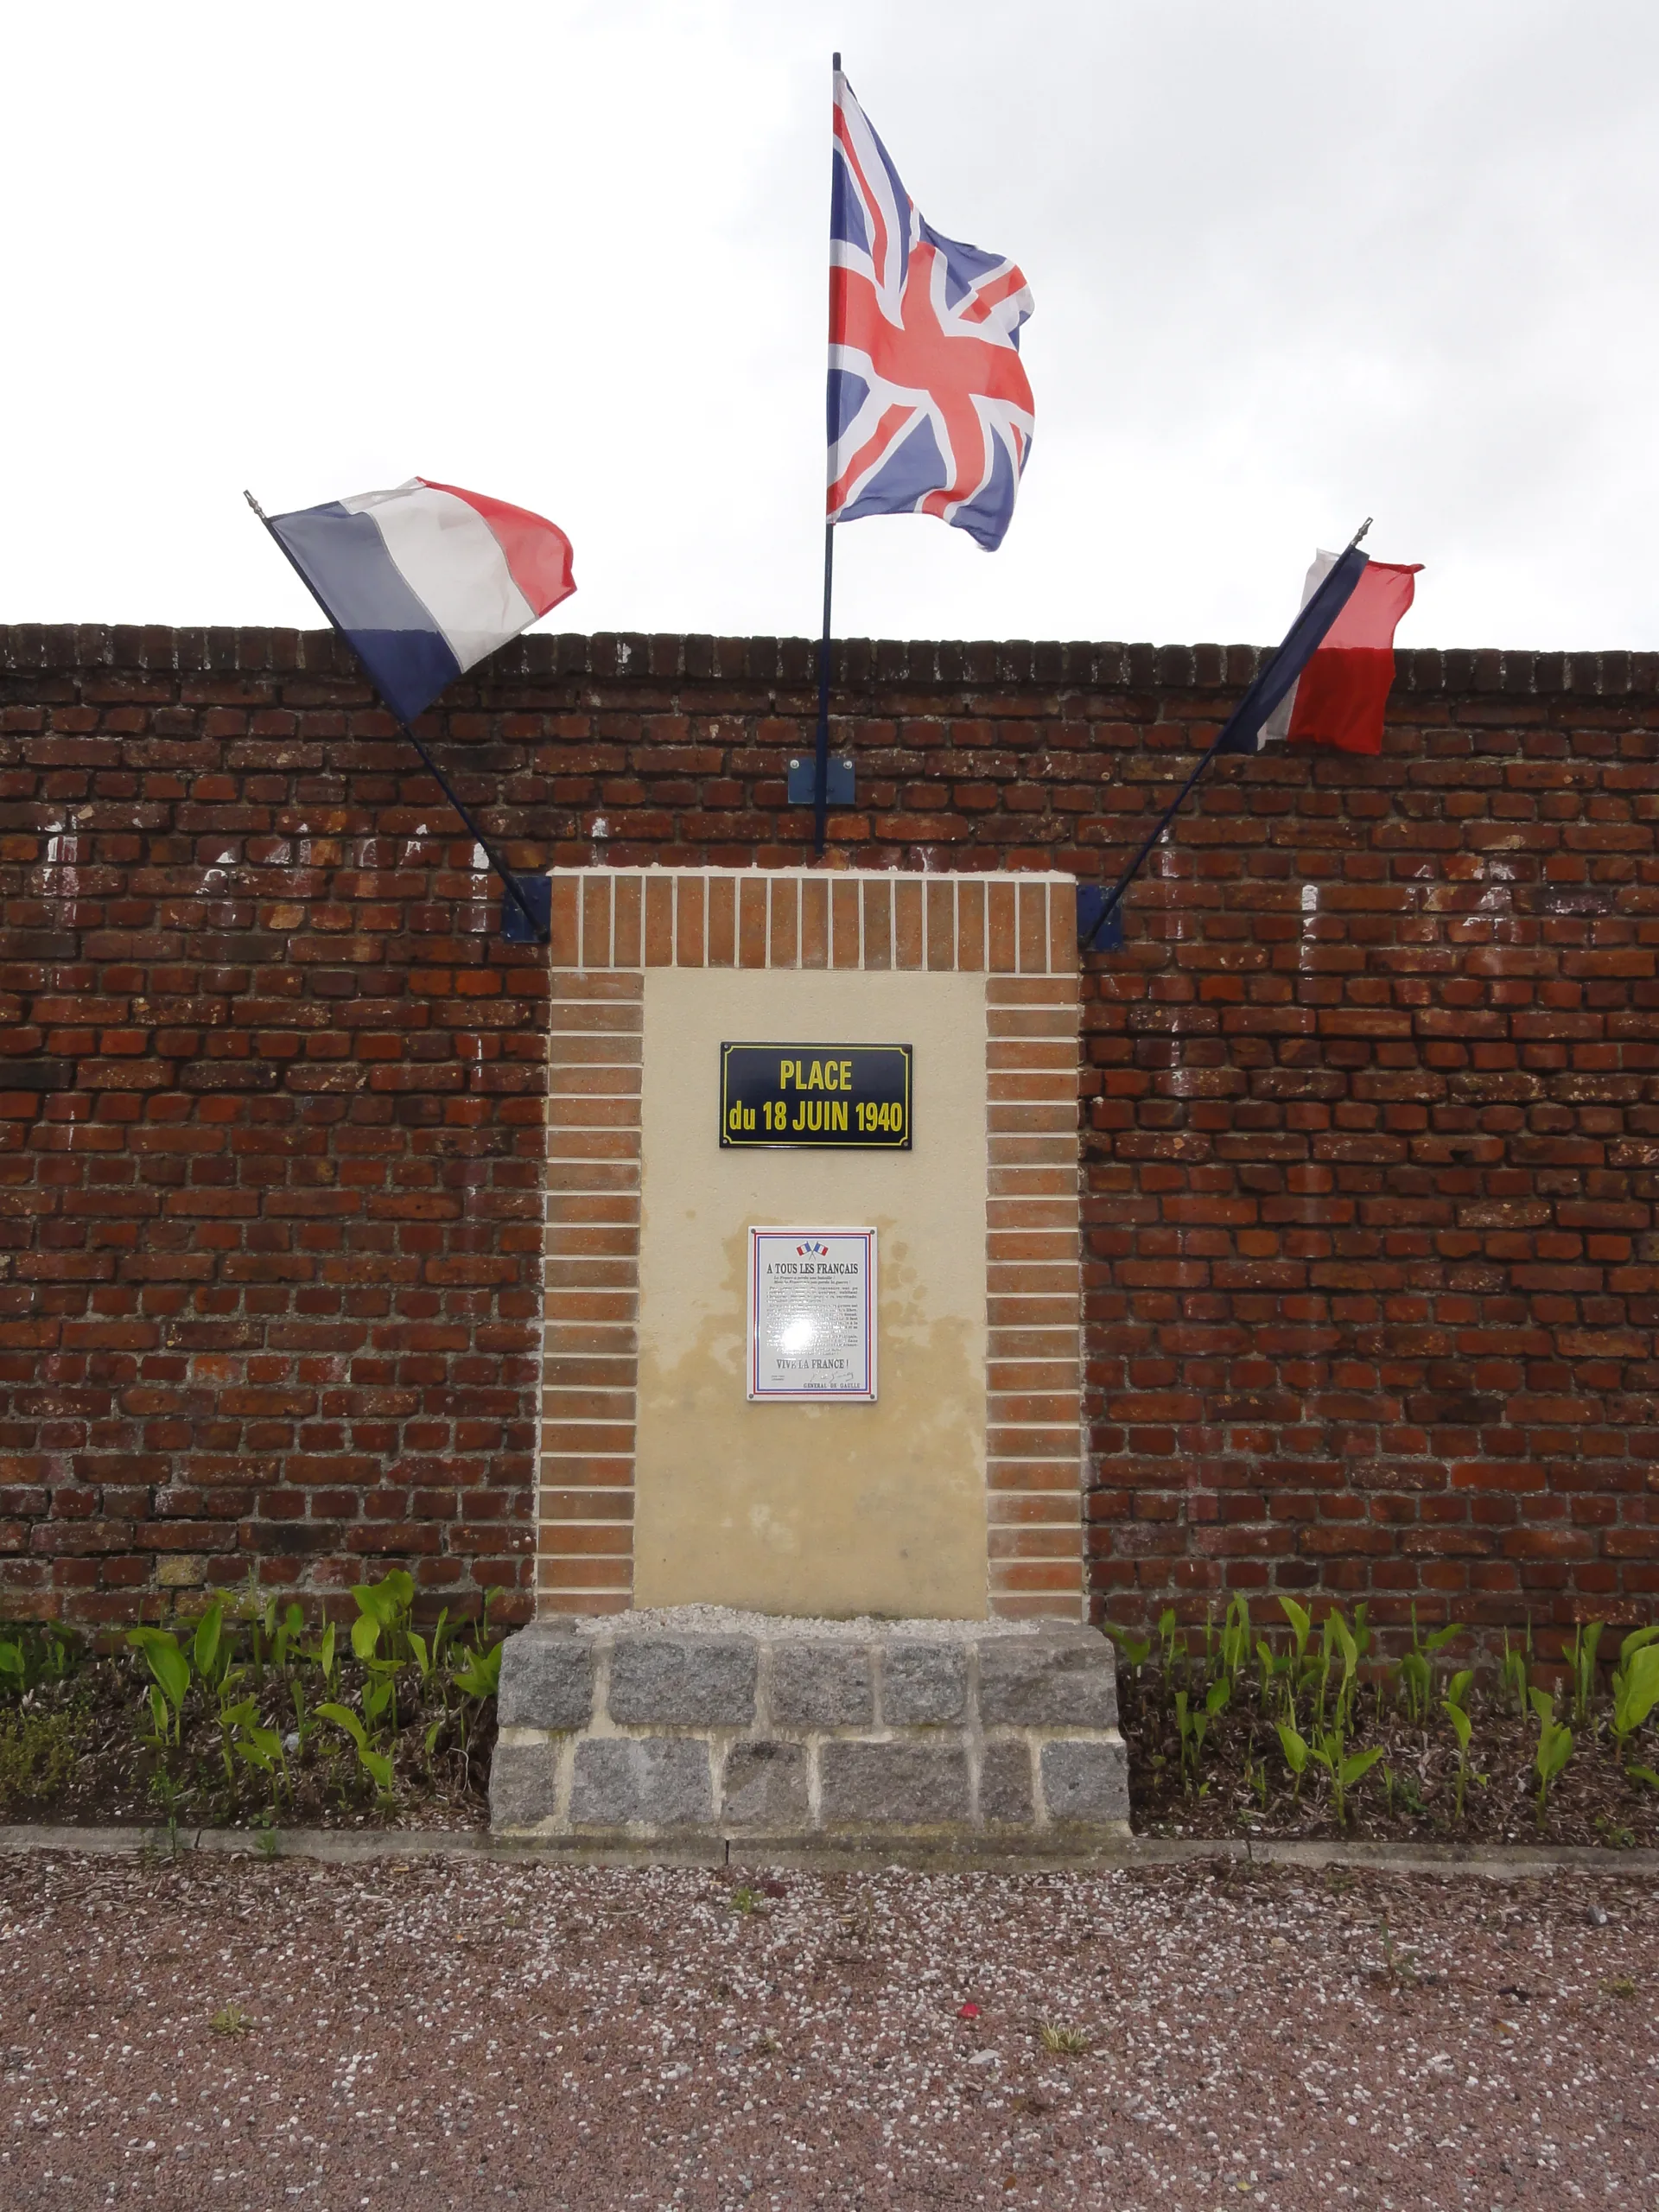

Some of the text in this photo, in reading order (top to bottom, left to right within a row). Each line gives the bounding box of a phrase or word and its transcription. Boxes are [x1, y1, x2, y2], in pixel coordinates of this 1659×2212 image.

[780, 1060, 852, 1090] PLACE
[729, 1100, 902, 1131] du 18 JUIN 1940
[766, 1263, 859, 1275] A TOUS LES FRANÇAIS
[776, 1359, 797, 1369] VIVE
[798, 1359, 810, 1369] LA
[811, 1359, 844, 1369] FRANCE
